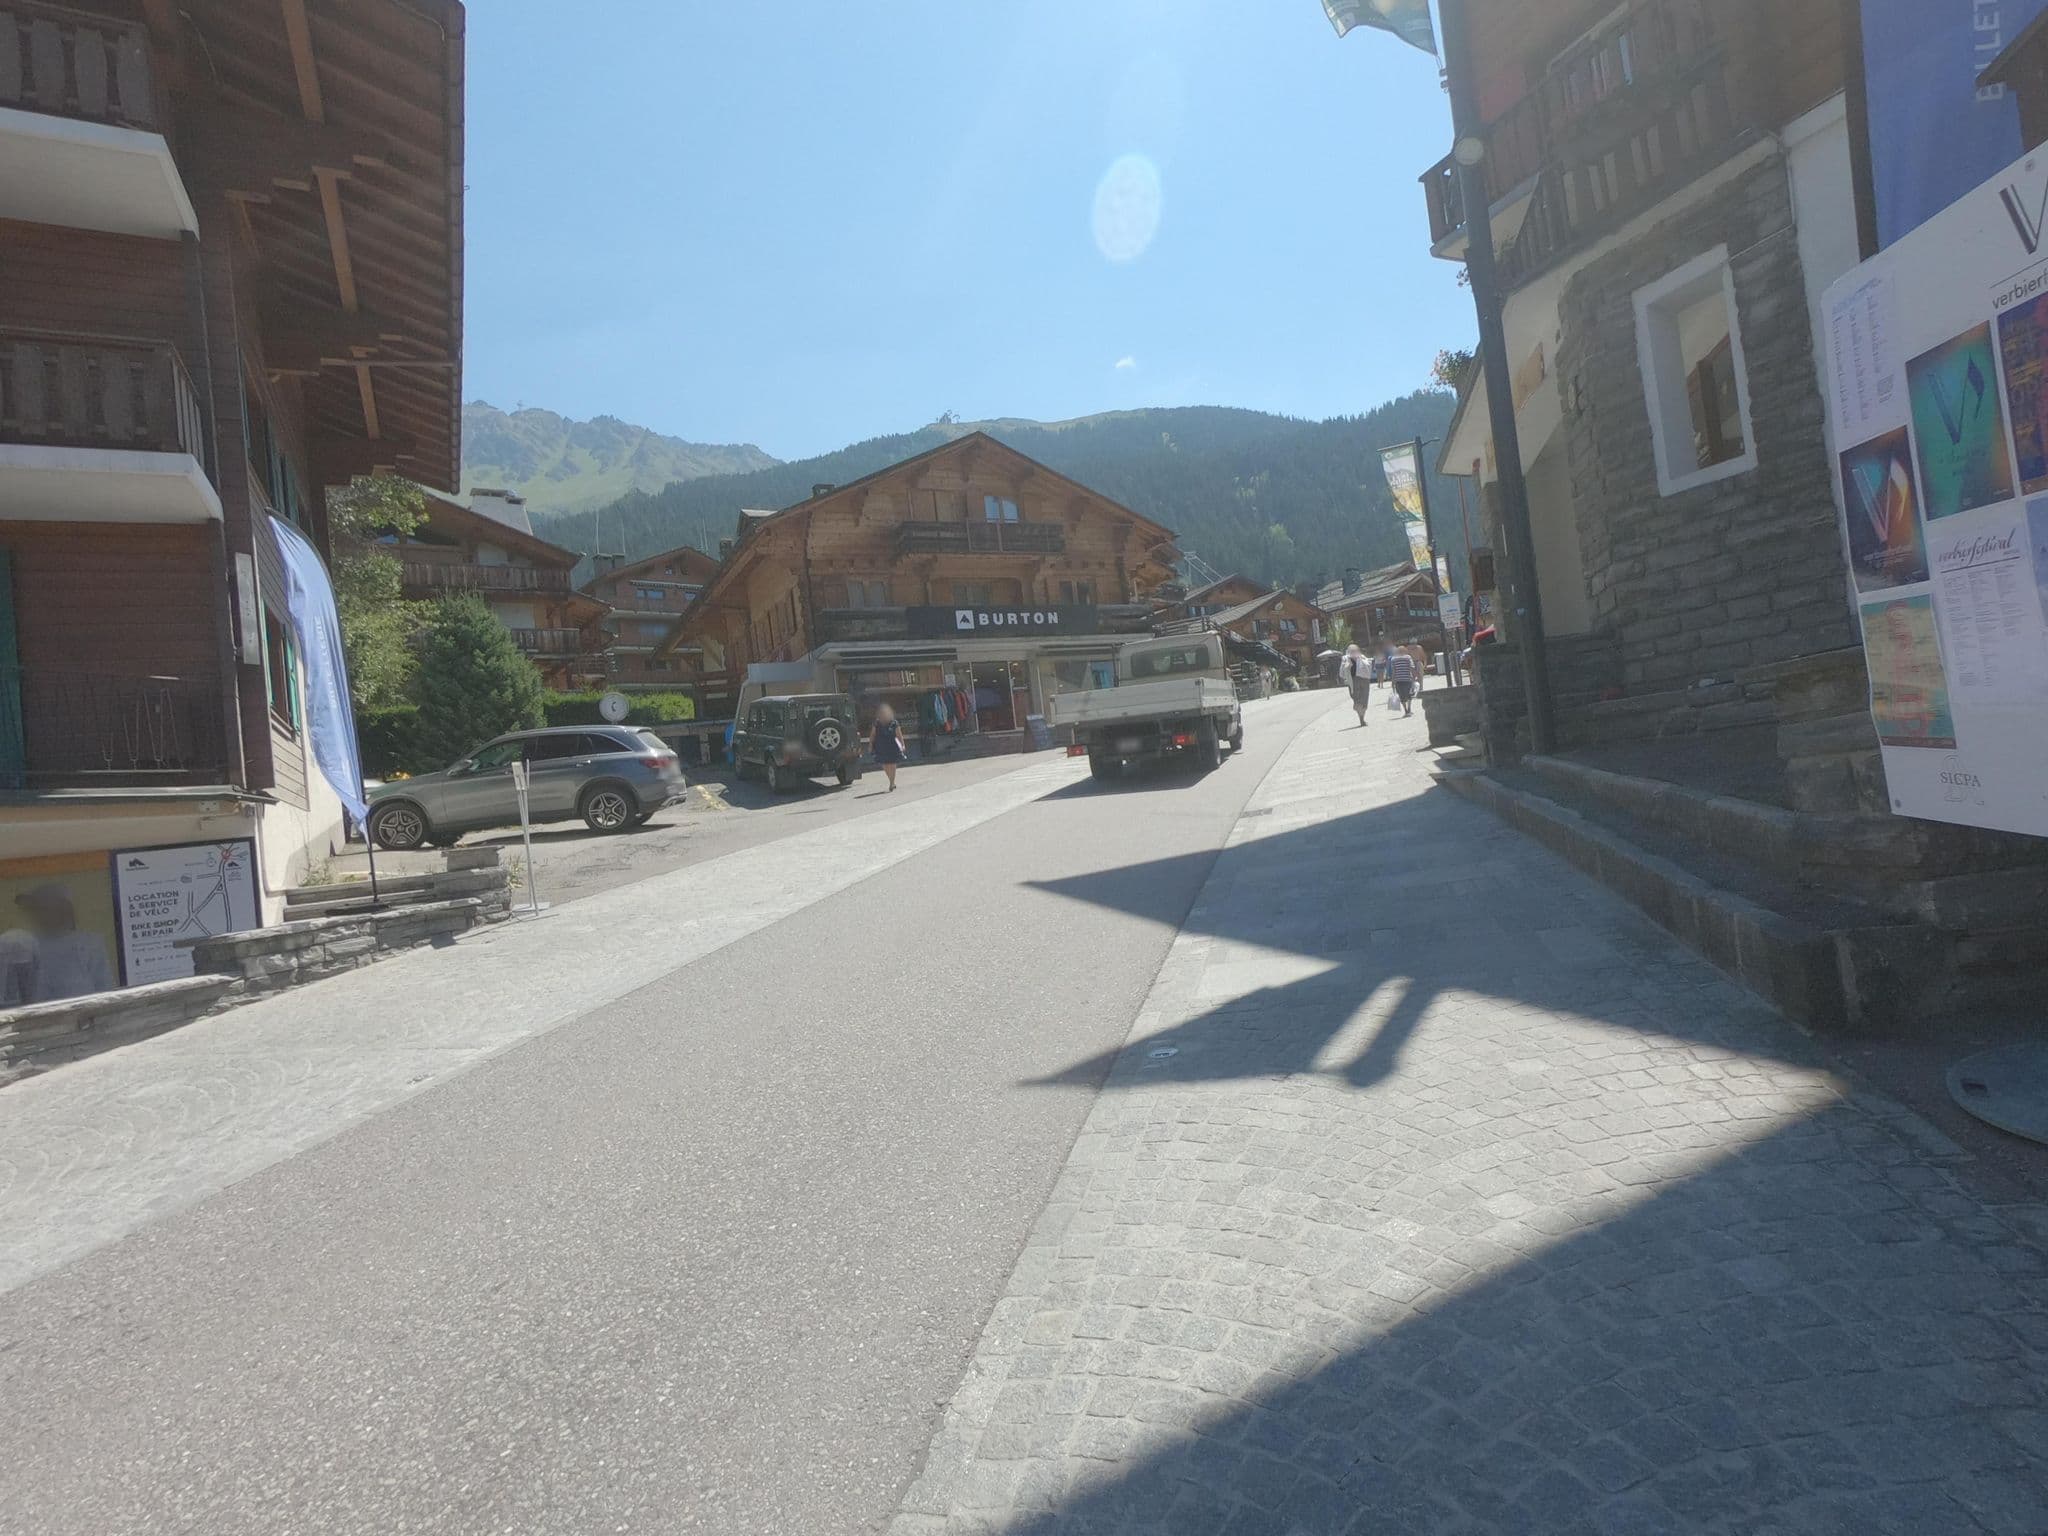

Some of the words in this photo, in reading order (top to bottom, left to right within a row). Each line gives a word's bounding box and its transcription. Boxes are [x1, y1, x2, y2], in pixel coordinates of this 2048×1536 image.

[978, 612, 1059, 626] BURTON
[1939, 768, 1982, 788] SICPA
[128, 890, 180, 903] LOCATION
[138, 898, 179, 910] SERVICE
[129, 910, 141, 919] DE
[131, 922, 152, 931] BIKE
[153, 918, 180, 929] SHOP
[141, 927, 174, 938] REPAIR
